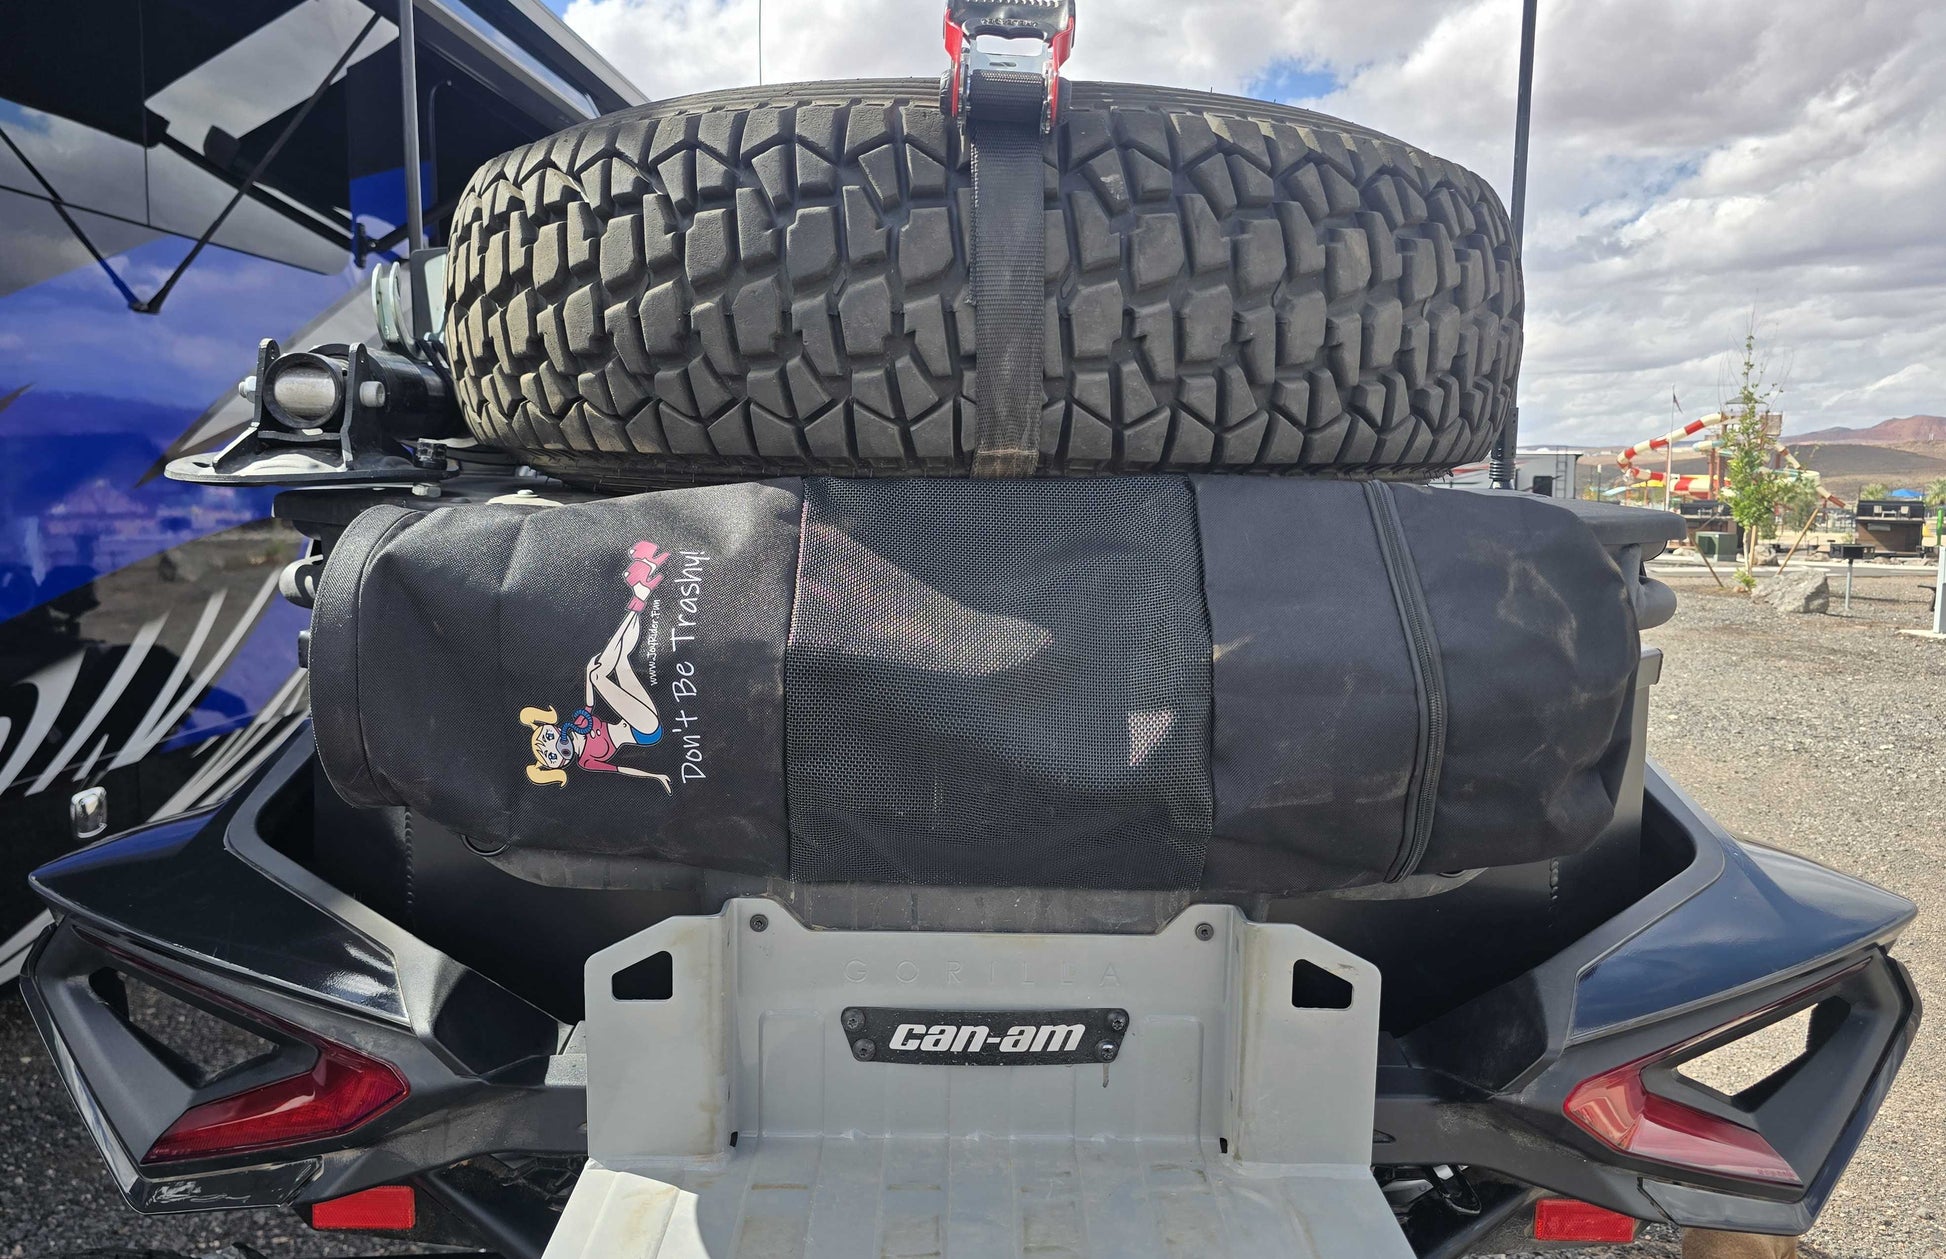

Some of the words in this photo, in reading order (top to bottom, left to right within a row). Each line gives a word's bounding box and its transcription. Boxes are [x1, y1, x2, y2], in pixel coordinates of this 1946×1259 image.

[669, 549, 711, 652] Trashy!
[646, 599, 661, 687] www.JoyRider.Fun
[672, 660, 698, 703] Be
[673, 709, 707, 784] Don't
[842, 959, 1121, 987] GORILLA
[889, 1023, 1086, 1053] can-am
